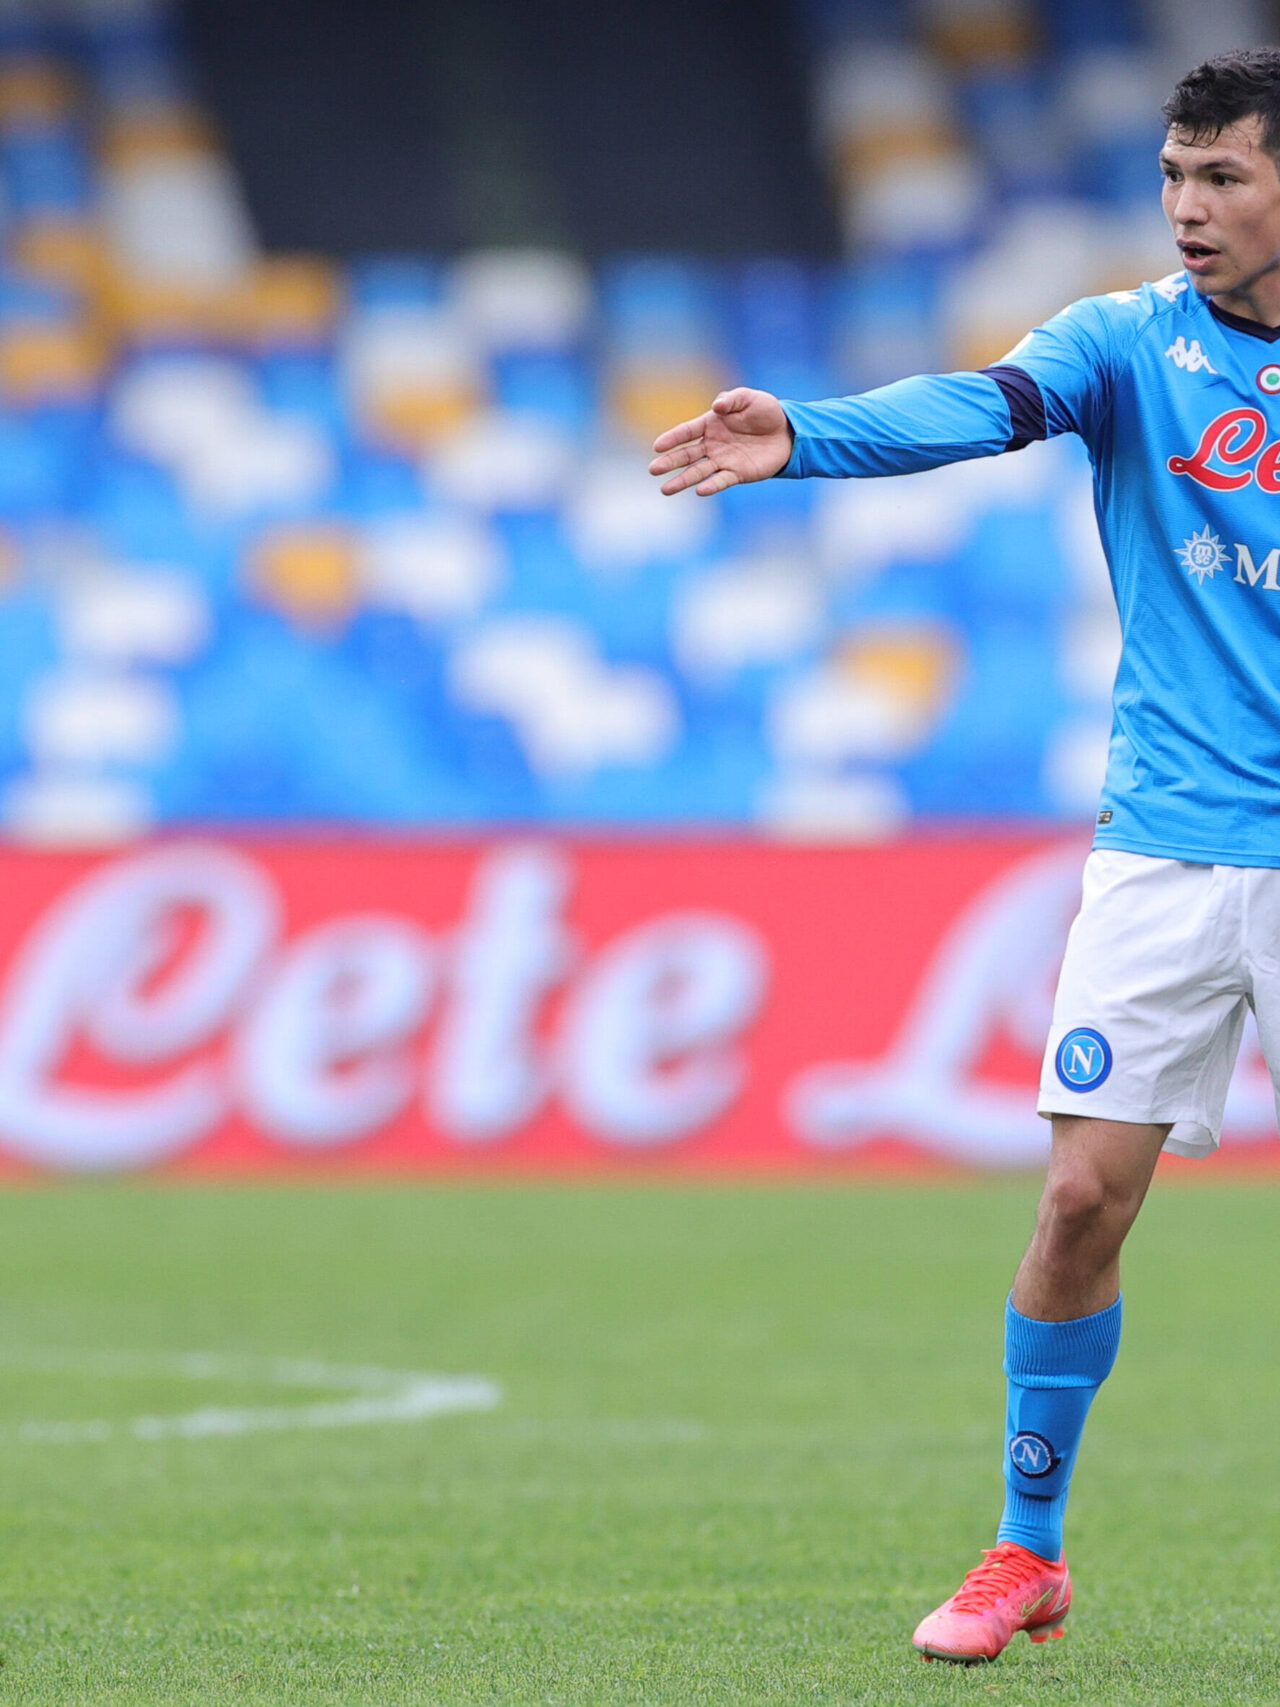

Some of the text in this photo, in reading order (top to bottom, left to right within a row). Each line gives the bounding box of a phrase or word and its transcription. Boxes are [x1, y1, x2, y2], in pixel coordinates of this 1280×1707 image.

[0, 838, 774, 1174] Lete
[1068, 1044, 1098, 1076] N
[1017, 1441, 1041, 1468] N
